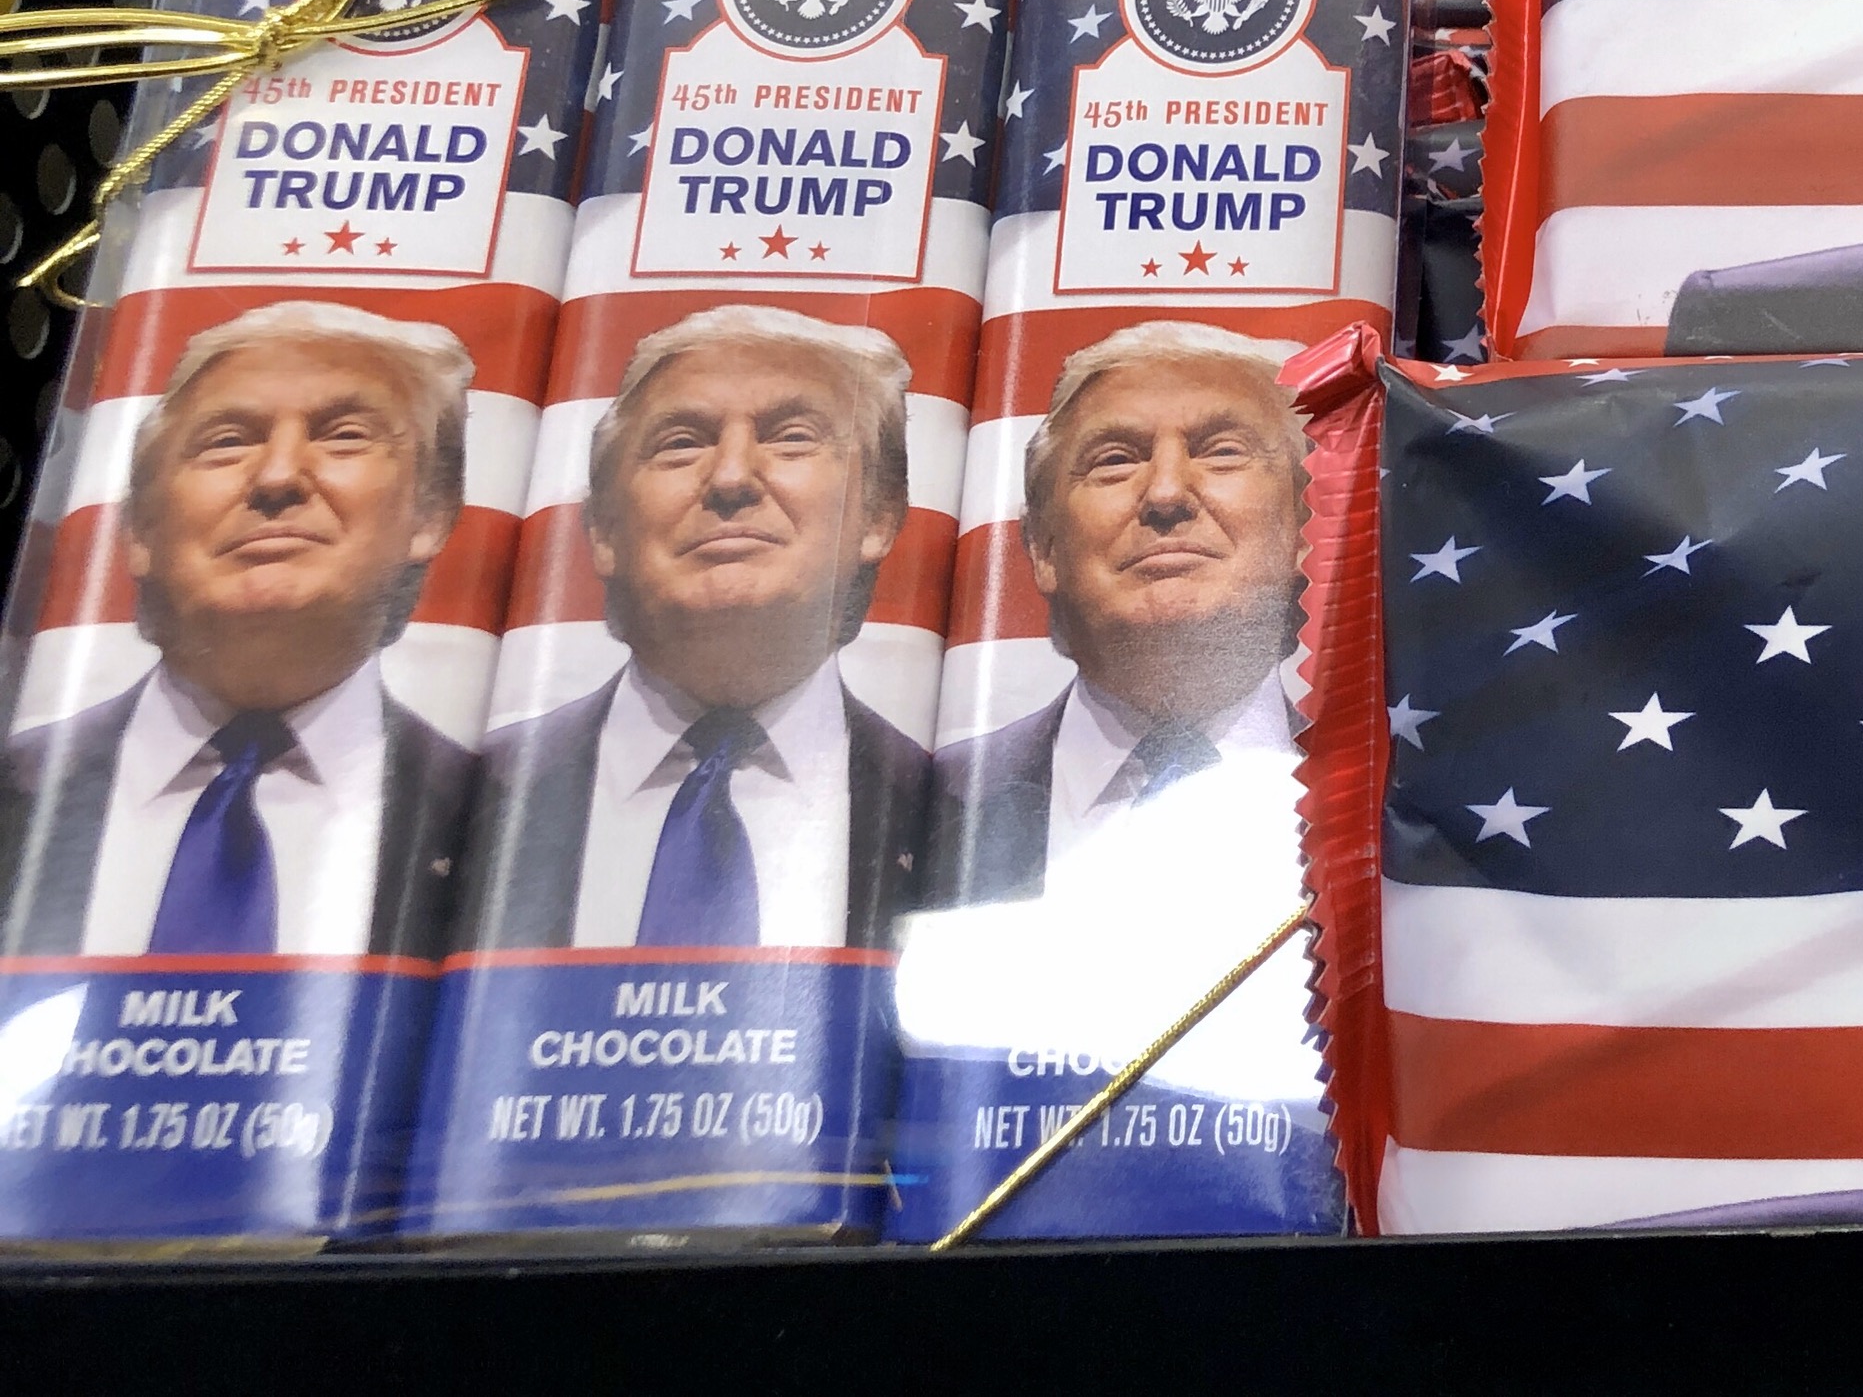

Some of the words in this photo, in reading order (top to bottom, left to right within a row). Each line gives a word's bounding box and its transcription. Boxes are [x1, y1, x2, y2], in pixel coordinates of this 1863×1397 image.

[328, 79, 503, 107] PRESIDENT
[671, 82, 738, 111] 45th
[753, 85, 923, 114] PRESIDENT
[1084, 99, 1149, 129] 45th
[1165, 100, 1329, 127] PRESIDENT
[236, 120, 488, 164] DONALD
[669, 126, 912, 170] DONALD
[1085, 143, 1322, 183] DONALD
[244, 169, 467, 212] TRUMP
[679, 175, 894, 217] TRUMP
[1095, 192, 1306, 232] TRUMP
[118, 989, 243, 1028] MILK
[613, 981, 730, 1017] MILK
[62, 1037, 311, 1078] HOCOLATE
[530, 1029, 798, 1068] CHOCOLATE
[0, 1103, 51, 1150] ET
[118, 1102, 189, 1151] 1.75
[191, 1102, 240, 1150] OZ
[489, 1094, 552, 1142] NET
[556, 1094, 608, 1142] WT.
[619, 1093, 685, 1139] 1.75
[691, 1092, 734, 1138] OZ
[740, 1091, 824, 1147] (50g)
[974, 1105, 1030, 1149] NET
[1100, 1104, 1157, 1147] 1.75
[1168, 1104, 1206, 1146] OZ
[1214, 1104, 1292, 1156] (50g)
